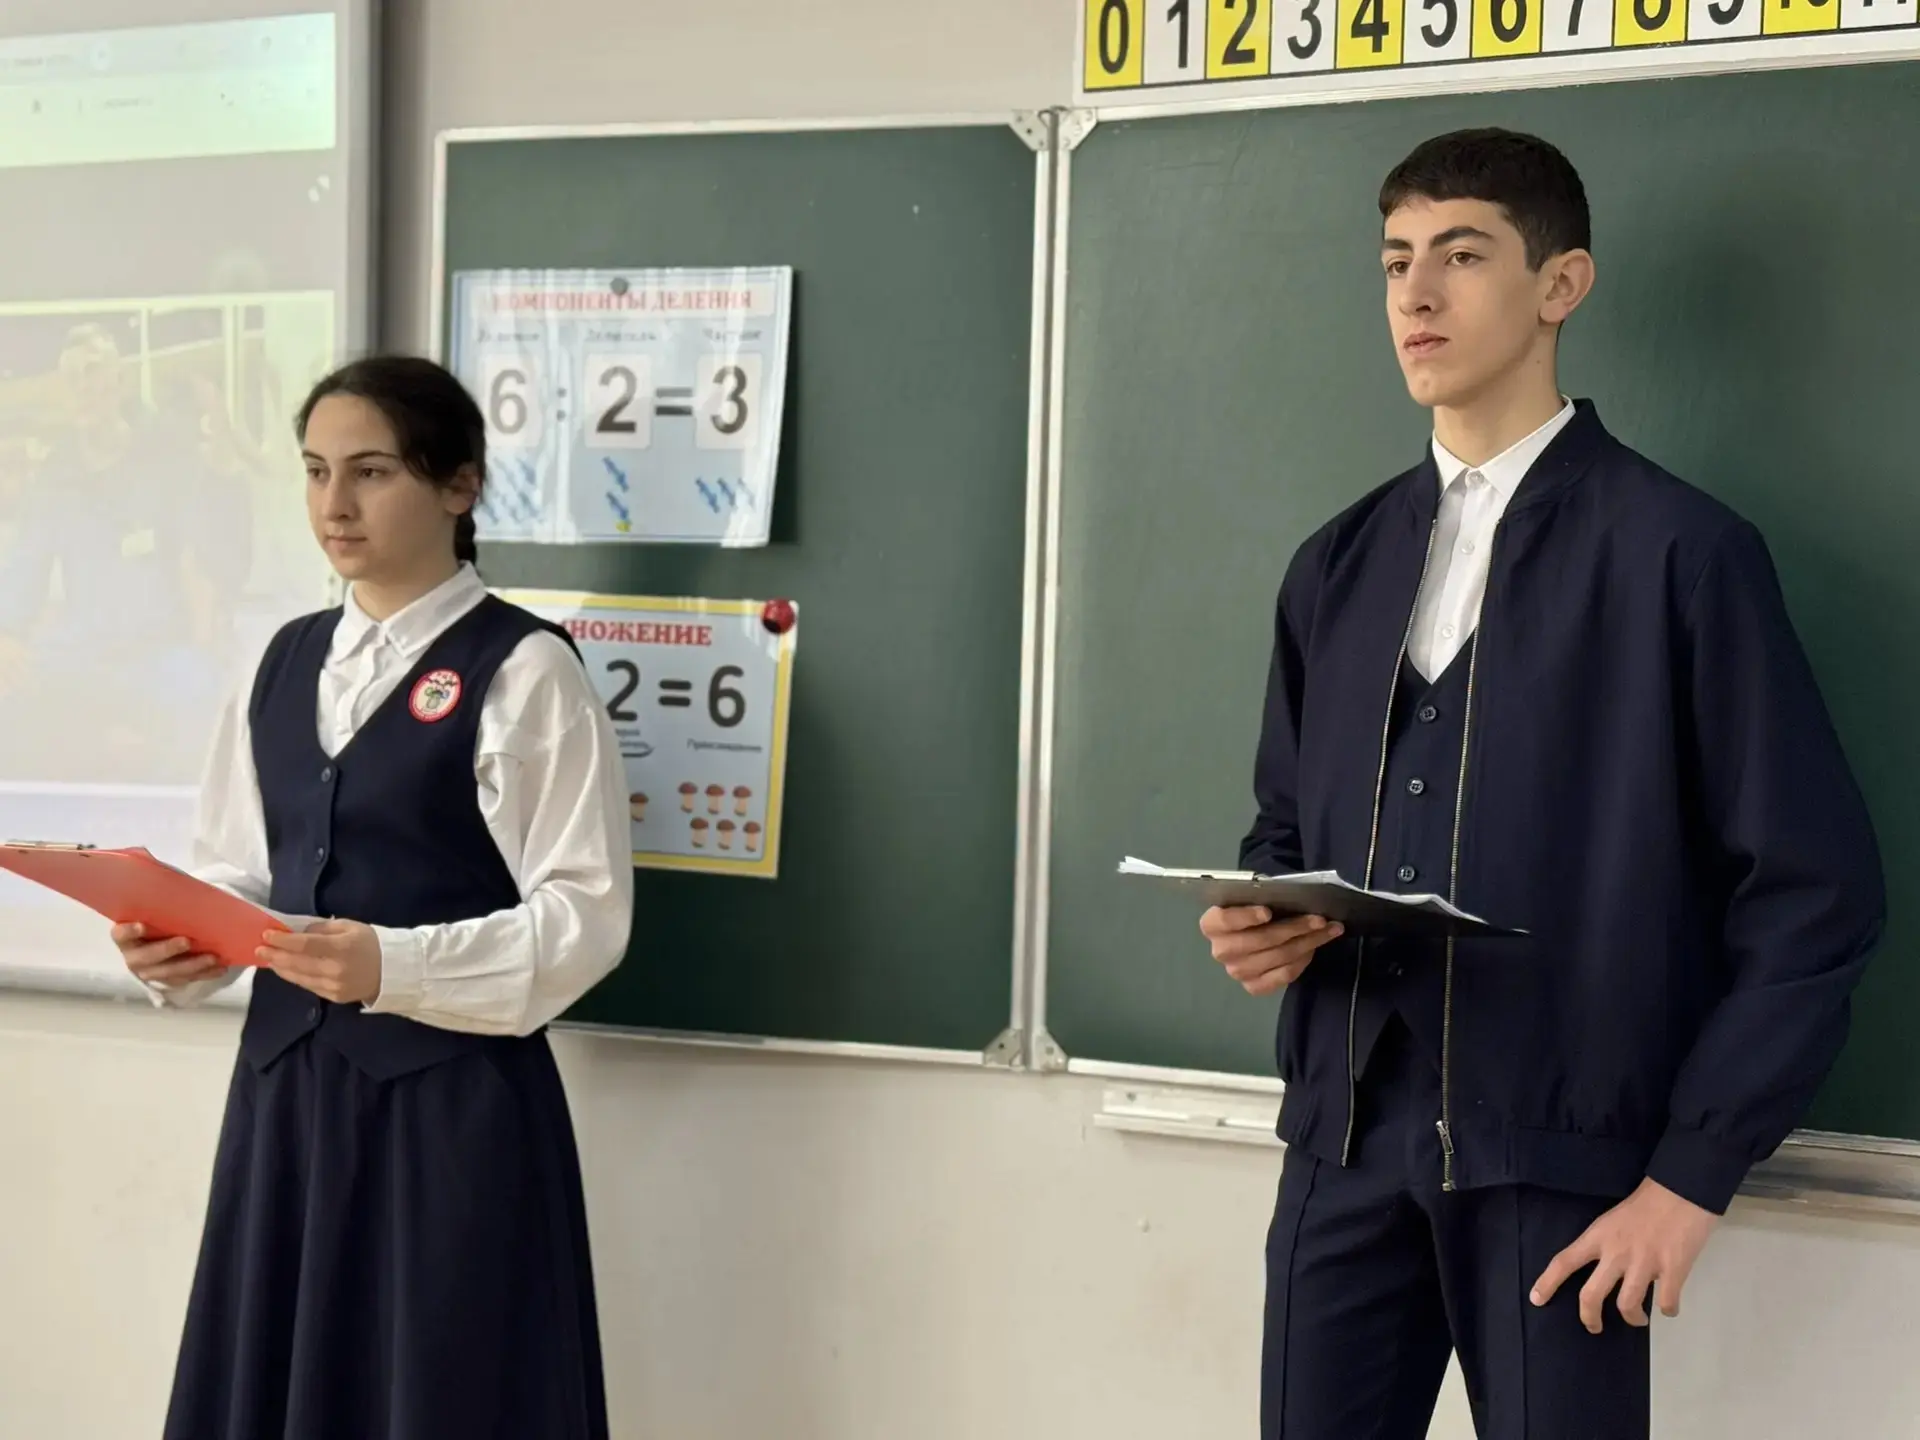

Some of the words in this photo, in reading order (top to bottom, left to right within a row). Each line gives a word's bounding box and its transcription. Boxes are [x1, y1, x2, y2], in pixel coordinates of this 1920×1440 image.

[1098, 0, 1129, 75] 0
[1166, 0, 1190, 69] 1
[1221, 0, 1257, 65] 2
[1287, 0, 1322, 60] 3
[1350, 0, 1390, 53] 4
[1420, 0, 1458, 48] 5
[489, 369, 528, 435] 6
[596, 365, 638, 434] 2
[710, 365, 749, 435] 3
[562, 619, 713, 647] НОЖЕНИЕ
[605, 659, 640, 722] 2
[707, 664, 746, 729] 6
